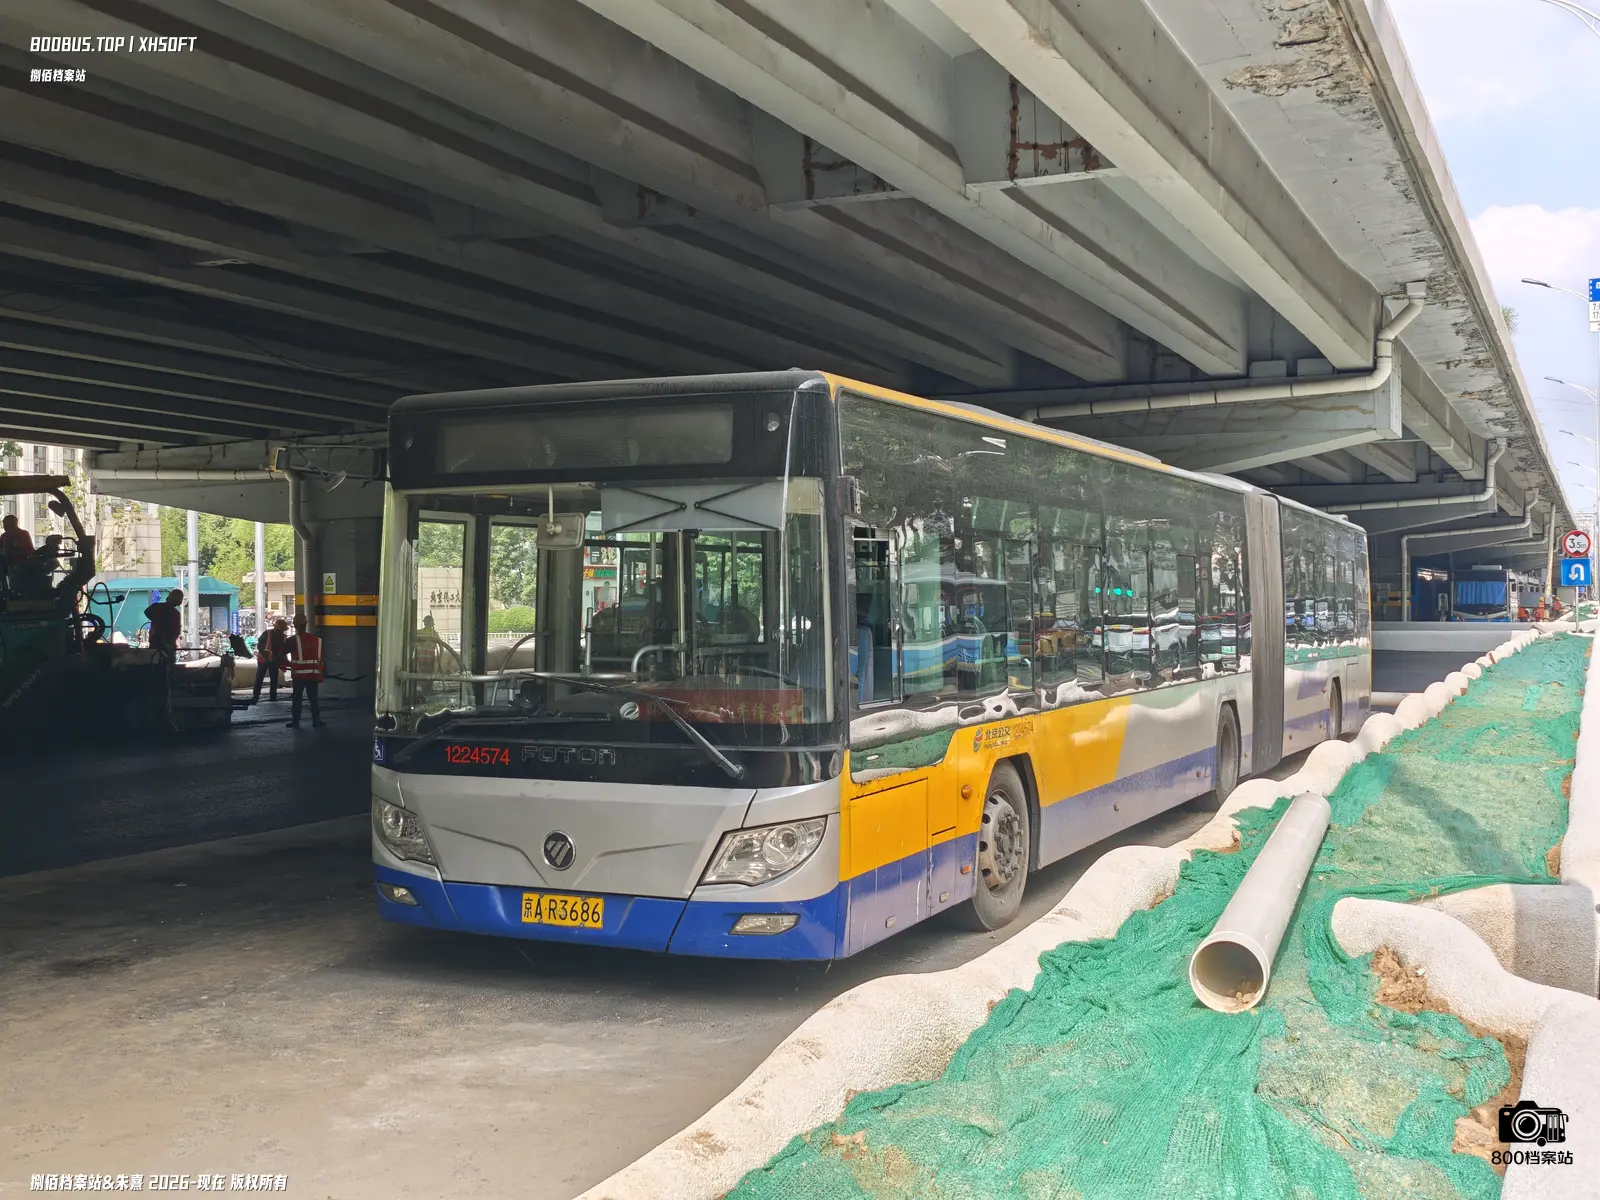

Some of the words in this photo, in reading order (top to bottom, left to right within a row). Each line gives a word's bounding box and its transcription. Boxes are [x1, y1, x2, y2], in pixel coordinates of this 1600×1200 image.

[1568, 538, 1587, 549] 3.5m
[985, 726, 1011, 741] 北京公交
[445, 745, 510, 766] 1224574
[521, 746, 616, 766] FOTON
